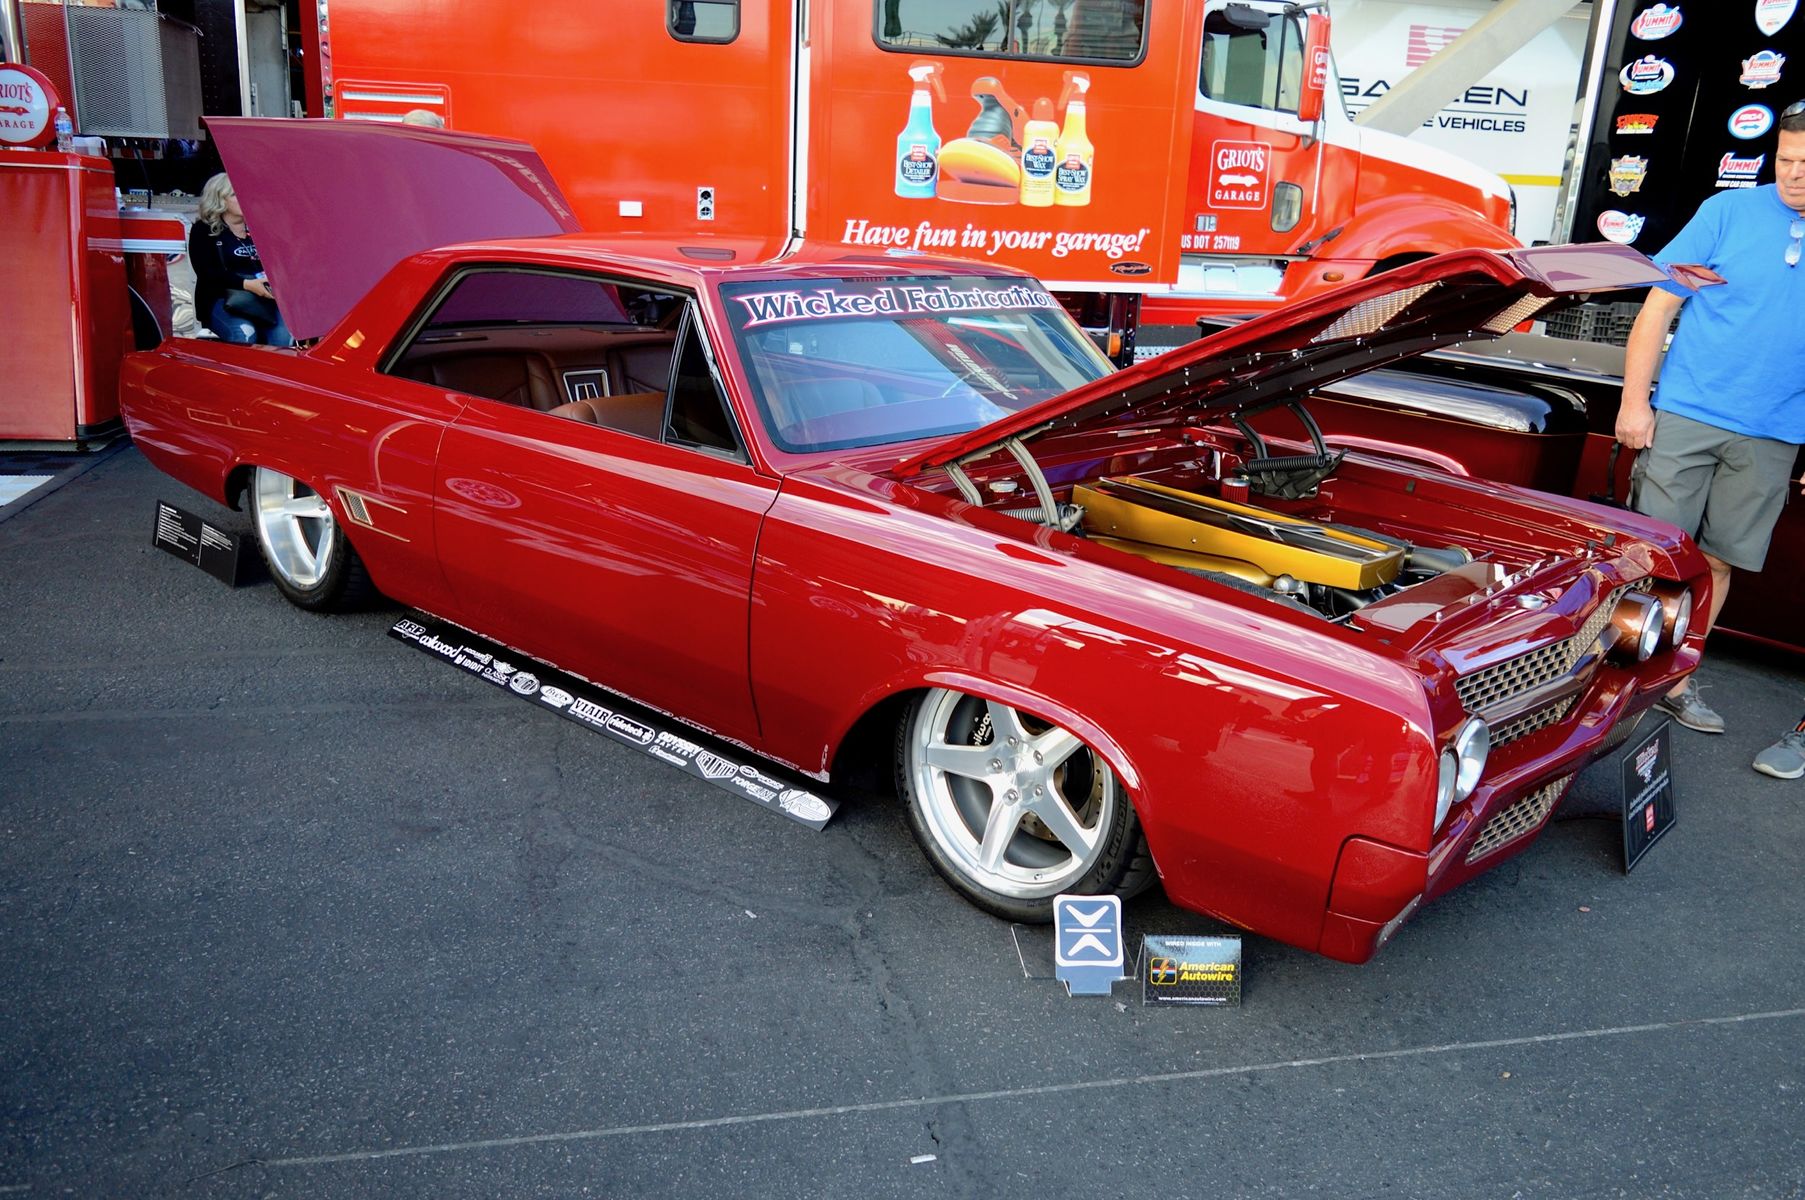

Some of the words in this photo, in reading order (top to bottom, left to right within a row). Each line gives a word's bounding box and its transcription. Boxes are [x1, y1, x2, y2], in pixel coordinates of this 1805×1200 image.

[0, 82, 33, 103] RIOT'S
[1339, 77, 1528, 107] SAEN
[0, 119, 35, 129] ARAGE
[1438, 116, 1526, 133] VEHICLES
[1217, 147, 1265, 172] GRIOT'S
[1719, 154, 1762, 173] SUMMIT
[1215, 190, 1260, 201] GARAGE
[842, 219, 910, 246] Have
[906, 221, 957, 251] fun
[961, 223, 987, 248] in
[986, 229, 1052, 256] your
[1051, 228, 1146, 259] garage!
[1181, 235, 1192, 249] US
[1194, 235, 1211, 249] DOT
[744, 286, 895, 323] Wicked
[395, 619, 426, 636] ARP
[575, 700, 610, 722] VIAIR
[609, 717, 644, 738] ridetech
[973, 712, 991, 746] ilwoo
[654, 738, 696, 758] BATTERY
[1179, 961, 1235, 972] American
[1180, 971, 1234, 981] Autowire
